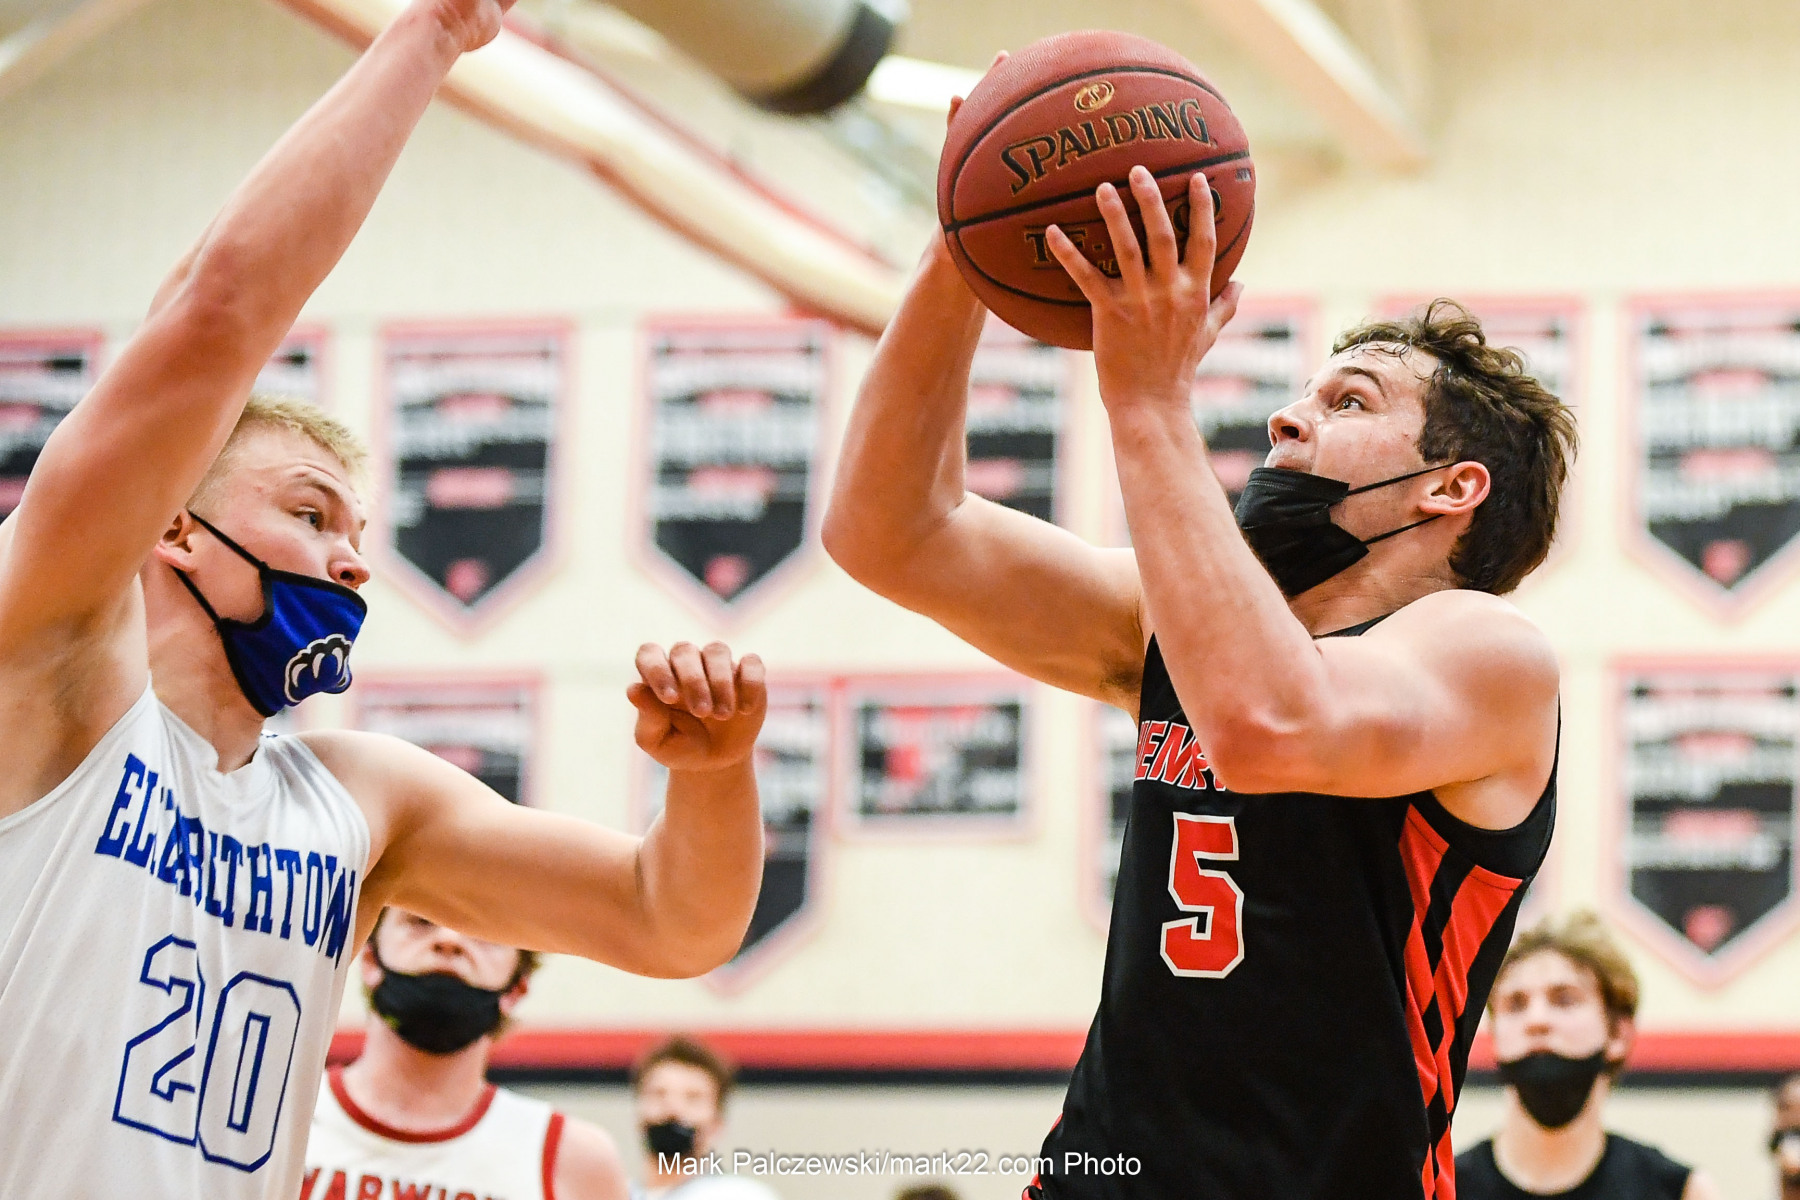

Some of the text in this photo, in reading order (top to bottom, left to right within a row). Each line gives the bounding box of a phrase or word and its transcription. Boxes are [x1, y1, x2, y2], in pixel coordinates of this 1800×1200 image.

[1000, 98, 1212, 196] SPALDING
[1159, 811, 1245, 979] 5
[112, 933, 302, 1174] 20
